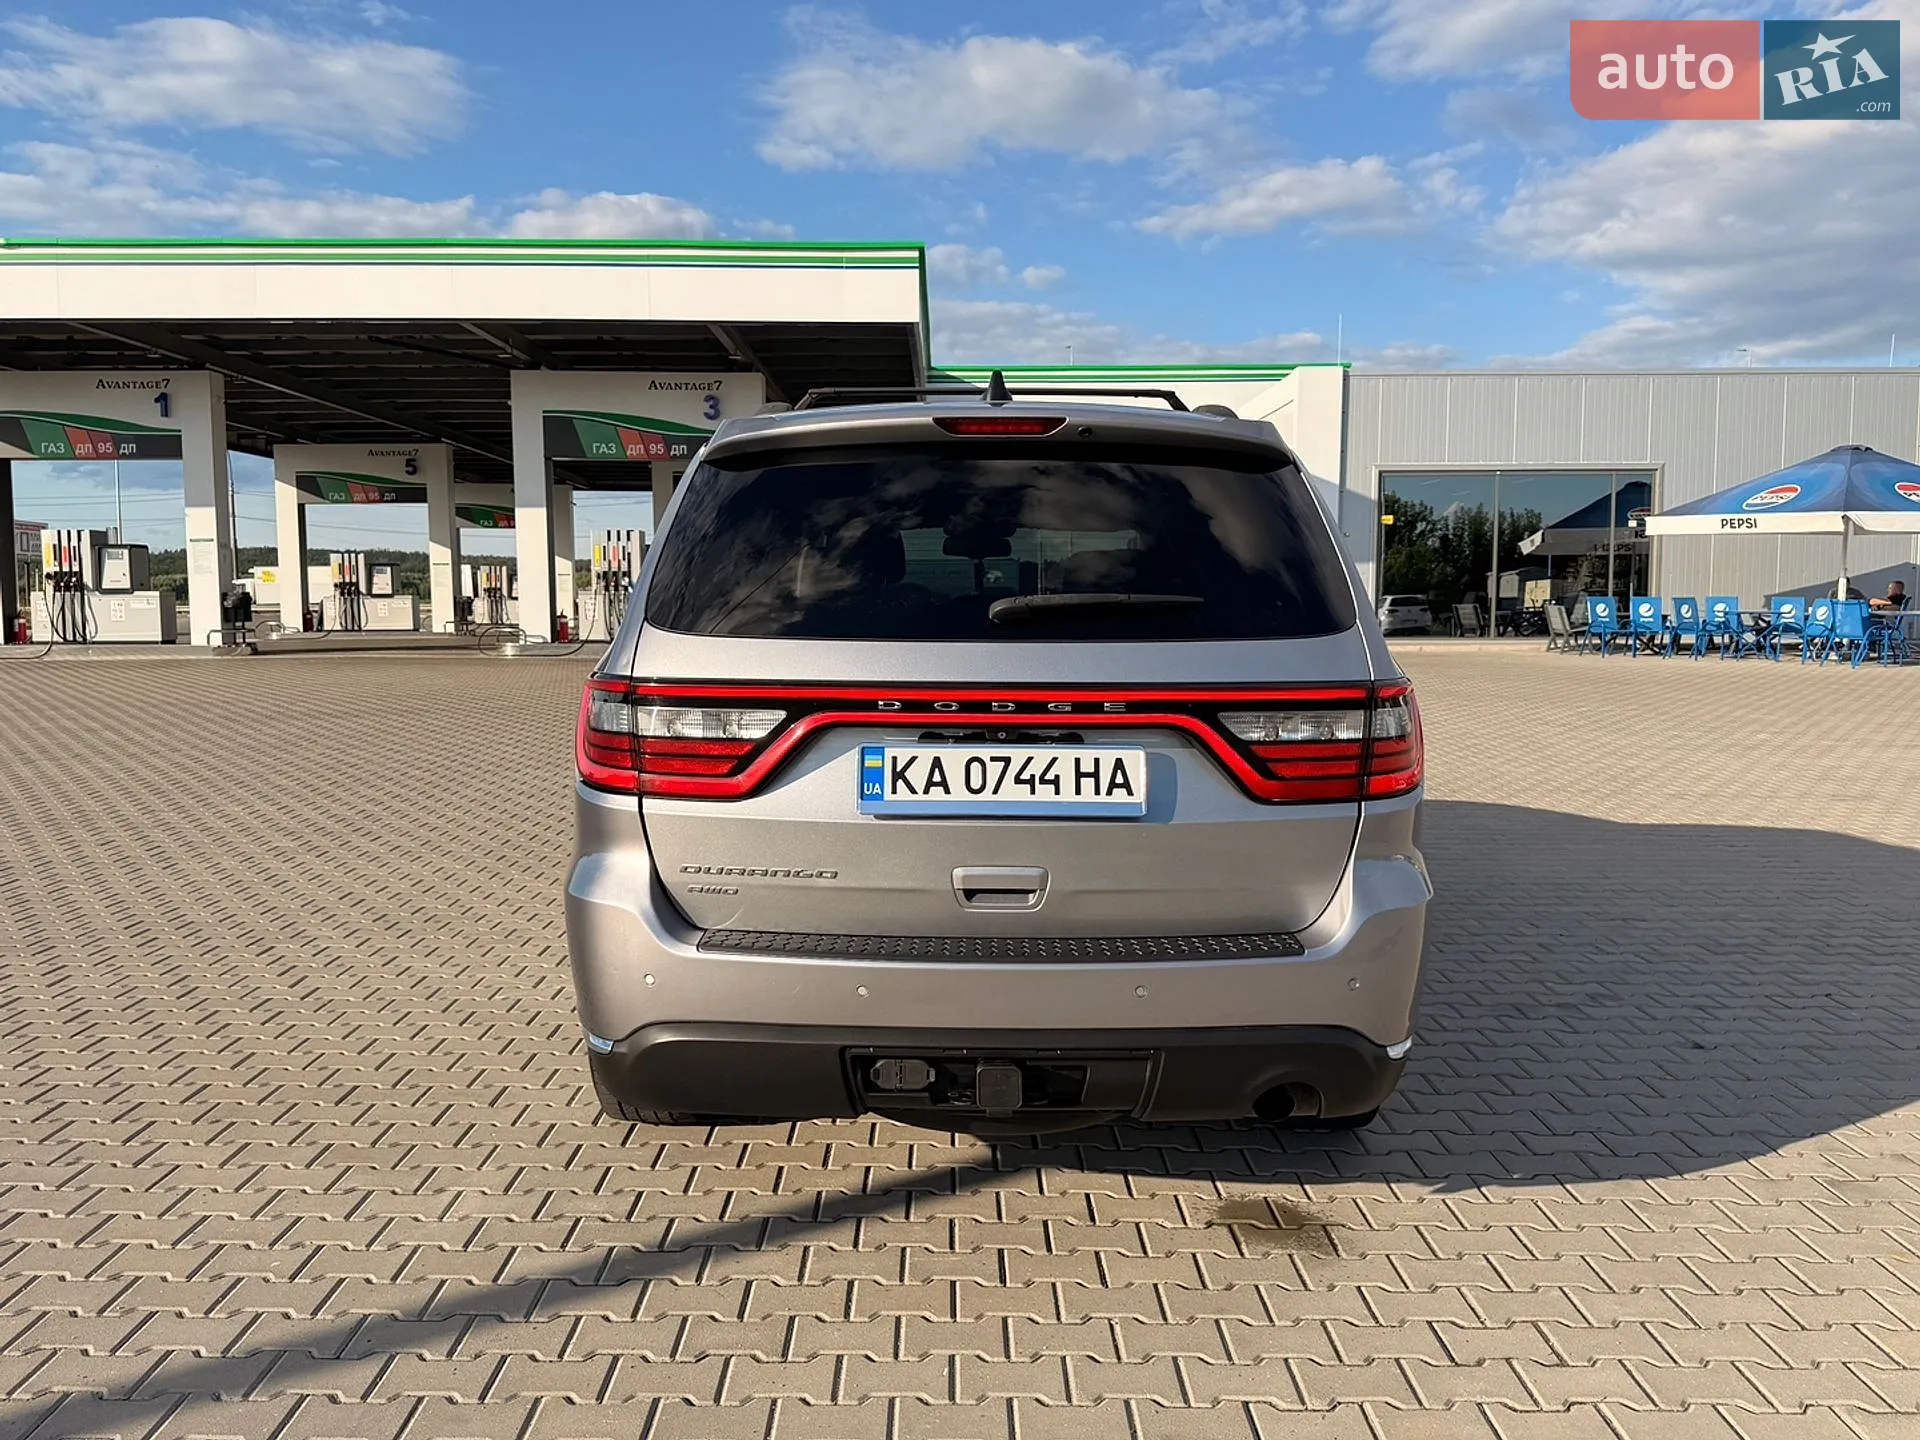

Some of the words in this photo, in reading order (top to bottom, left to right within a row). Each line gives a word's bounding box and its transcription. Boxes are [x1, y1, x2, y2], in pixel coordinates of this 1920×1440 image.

[154, 392, 170, 418] 1
[703, 394, 721, 421] 3
[41, 442, 65, 454] ГАЗ
[97, 442, 113, 454] 95
[592, 442, 617, 454] ГАЗ
[649, 443, 665, 455] 95
[405, 458, 418, 476] 5
[1720, 518, 1758, 530] PEPSI
[877, 700, 1127, 712] DODGE
[890, 755, 951, 796] KA
[964, 756, 1061, 797] 0744
[863, 782, 882, 795] UA
[679, 863, 839, 880] DURANGO
[686, 884, 740, 897] AWD
